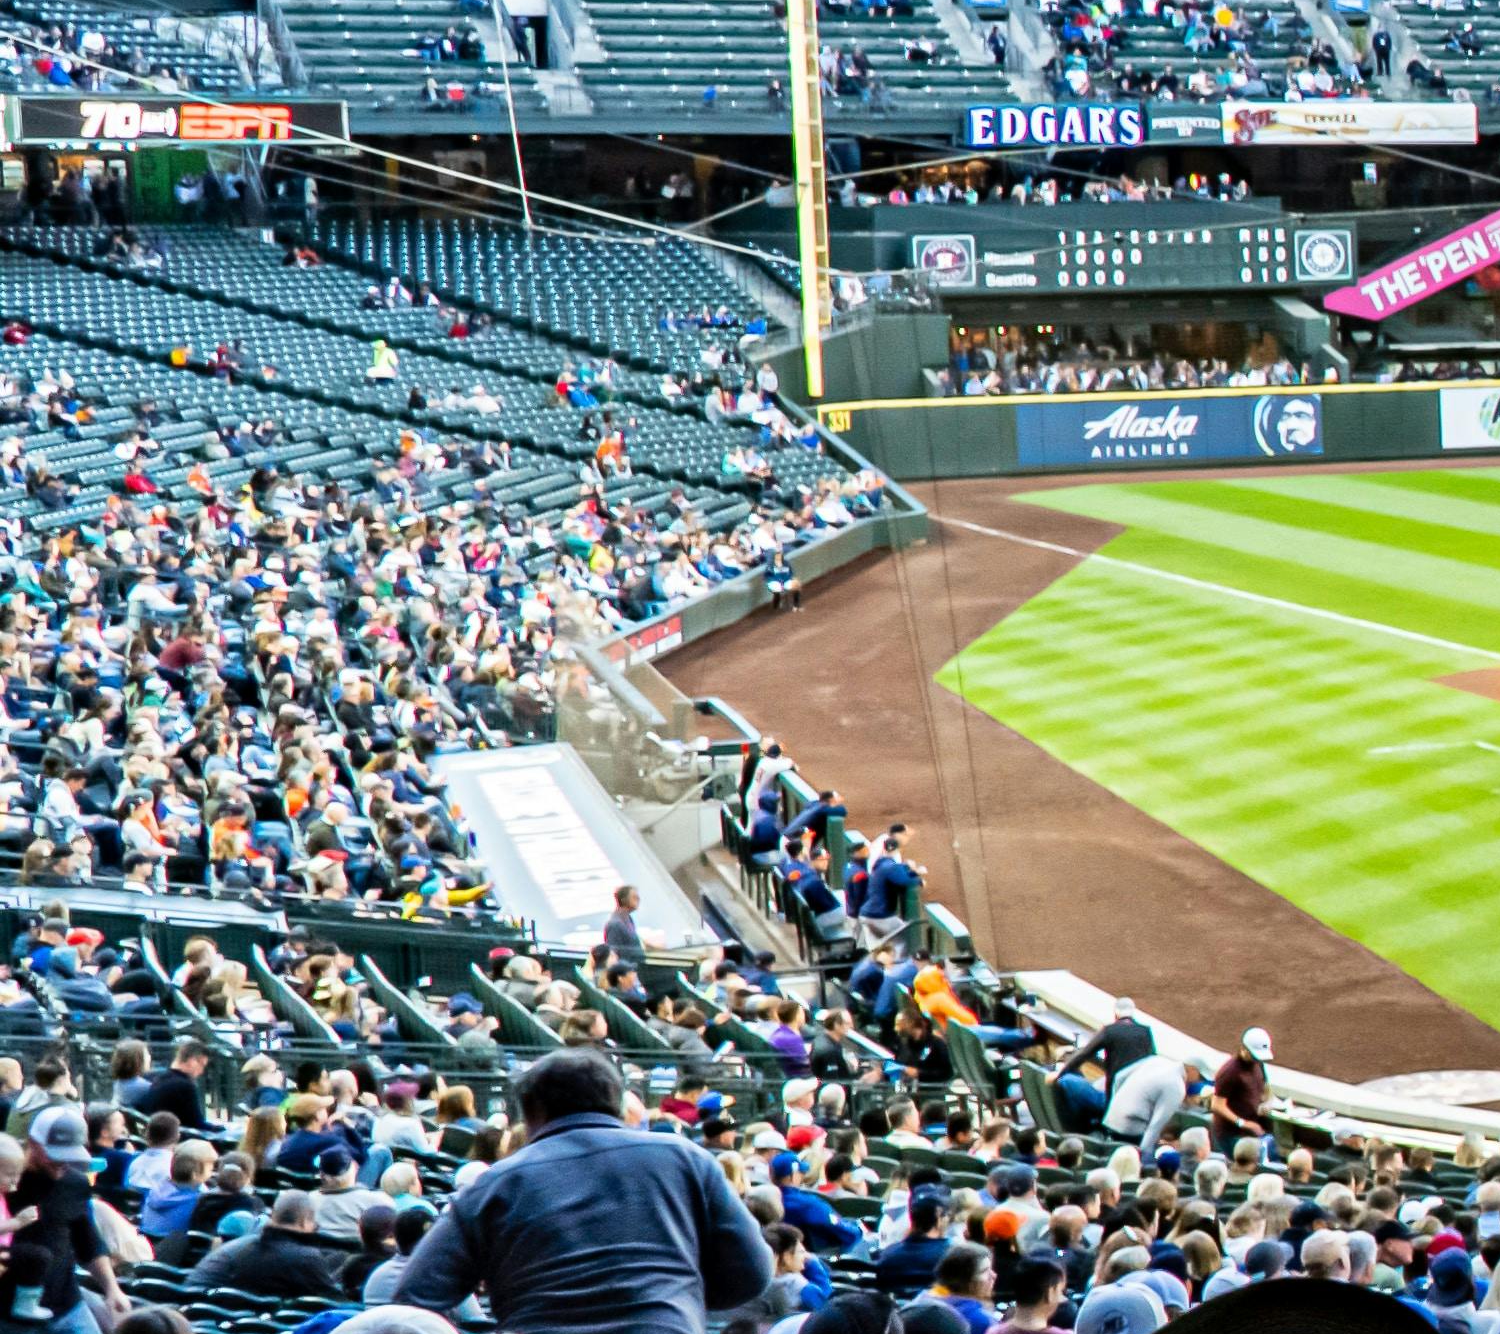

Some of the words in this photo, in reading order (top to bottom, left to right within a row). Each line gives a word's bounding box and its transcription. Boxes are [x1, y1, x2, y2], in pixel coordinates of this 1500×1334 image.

[80, 101, 140, 138] 710
[968, 106, 1144, 146] EDGAR'S
[1360, 264, 1428, 313] THE
[1083, 403, 1199, 440] Alaska
[1091, 443, 1190, 458] AIRLINES
